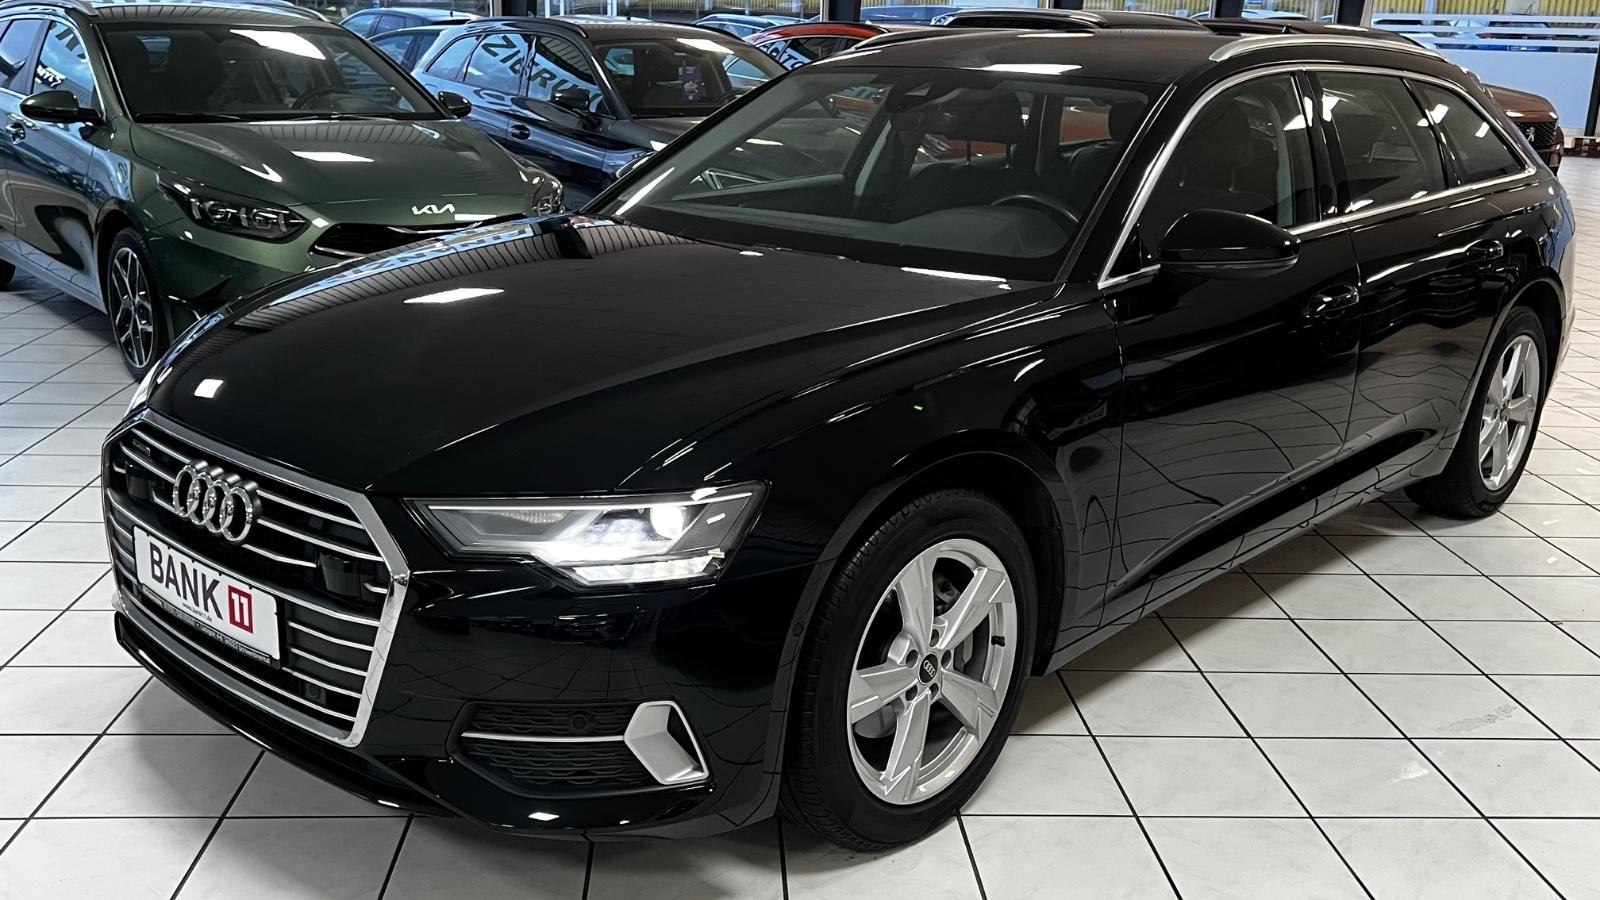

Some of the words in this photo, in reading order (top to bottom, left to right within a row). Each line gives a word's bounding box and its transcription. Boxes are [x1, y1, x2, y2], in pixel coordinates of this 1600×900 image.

[411, 203, 456, 216] KIA
[149, 541, 224, 621] BANK
[230, 591, 251, 630] 11
